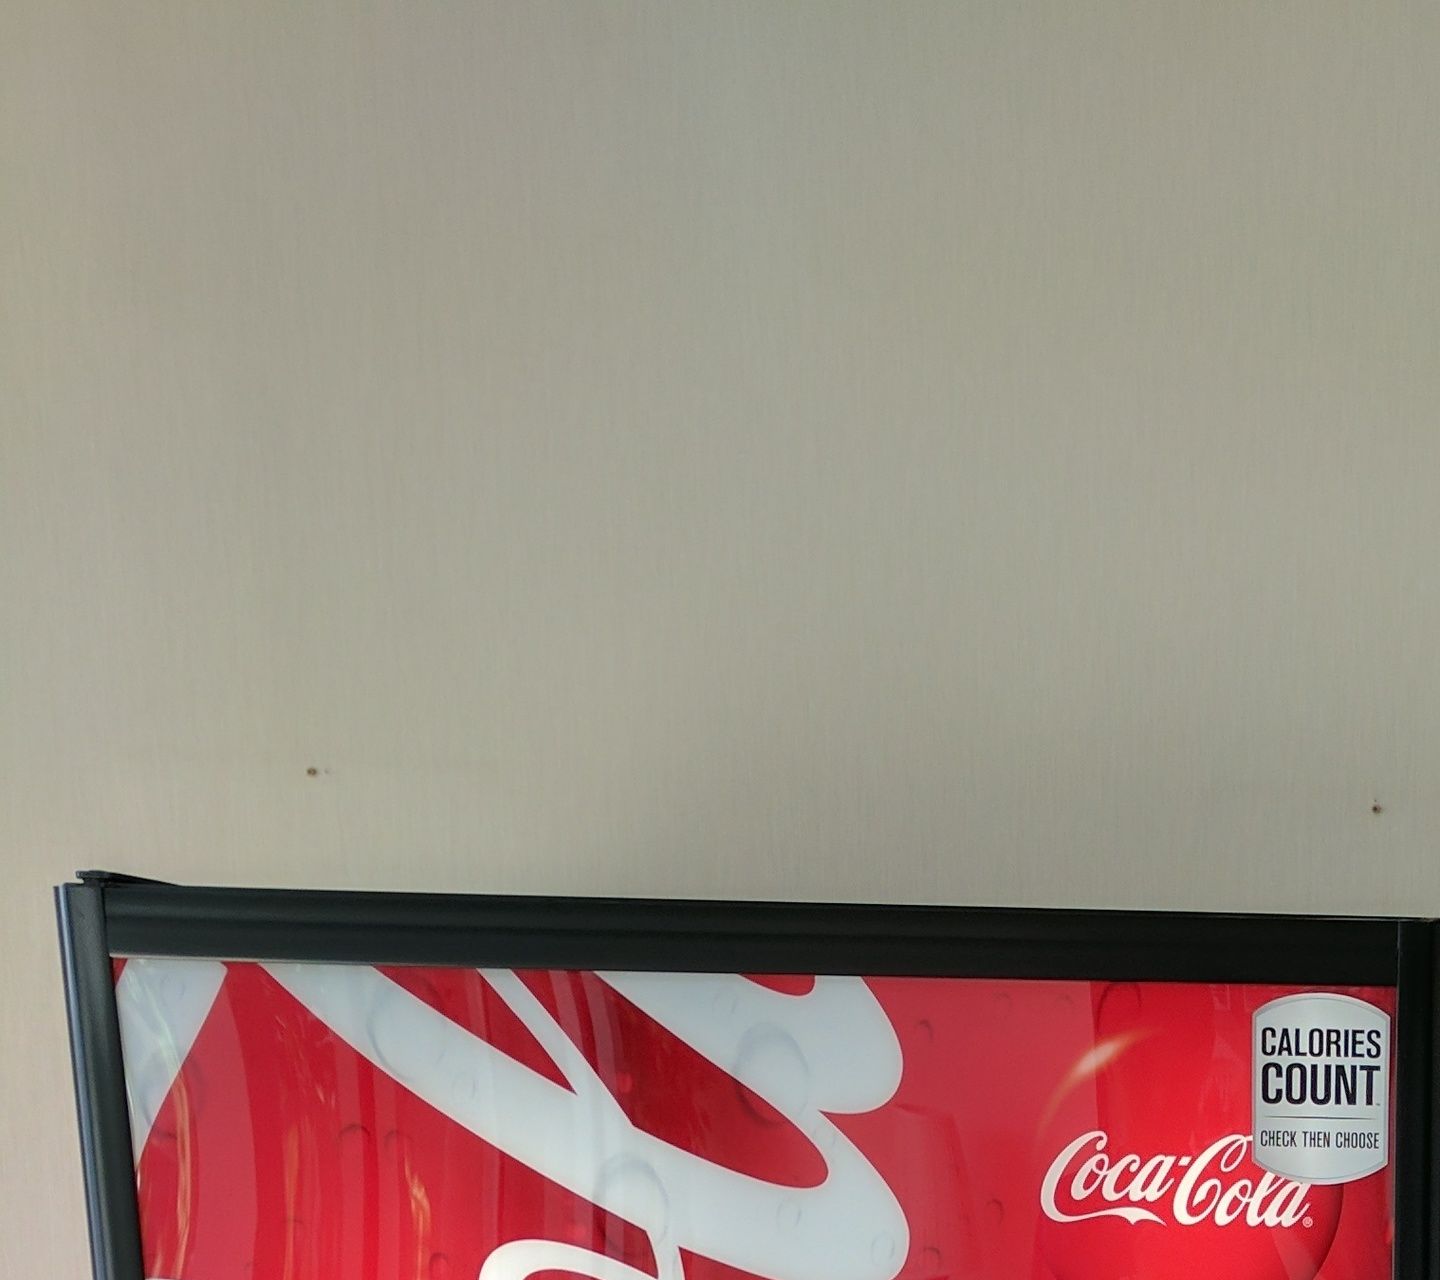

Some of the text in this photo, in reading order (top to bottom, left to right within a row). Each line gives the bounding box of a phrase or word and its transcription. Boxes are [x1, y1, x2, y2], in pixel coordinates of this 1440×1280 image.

[1261, 1027, 1381, 1059] CALORIES
[1261, 1062, 1380, 1106] COUNT
[1260, 1129, 1380, 1150] CHECK THEN CHOOSE
